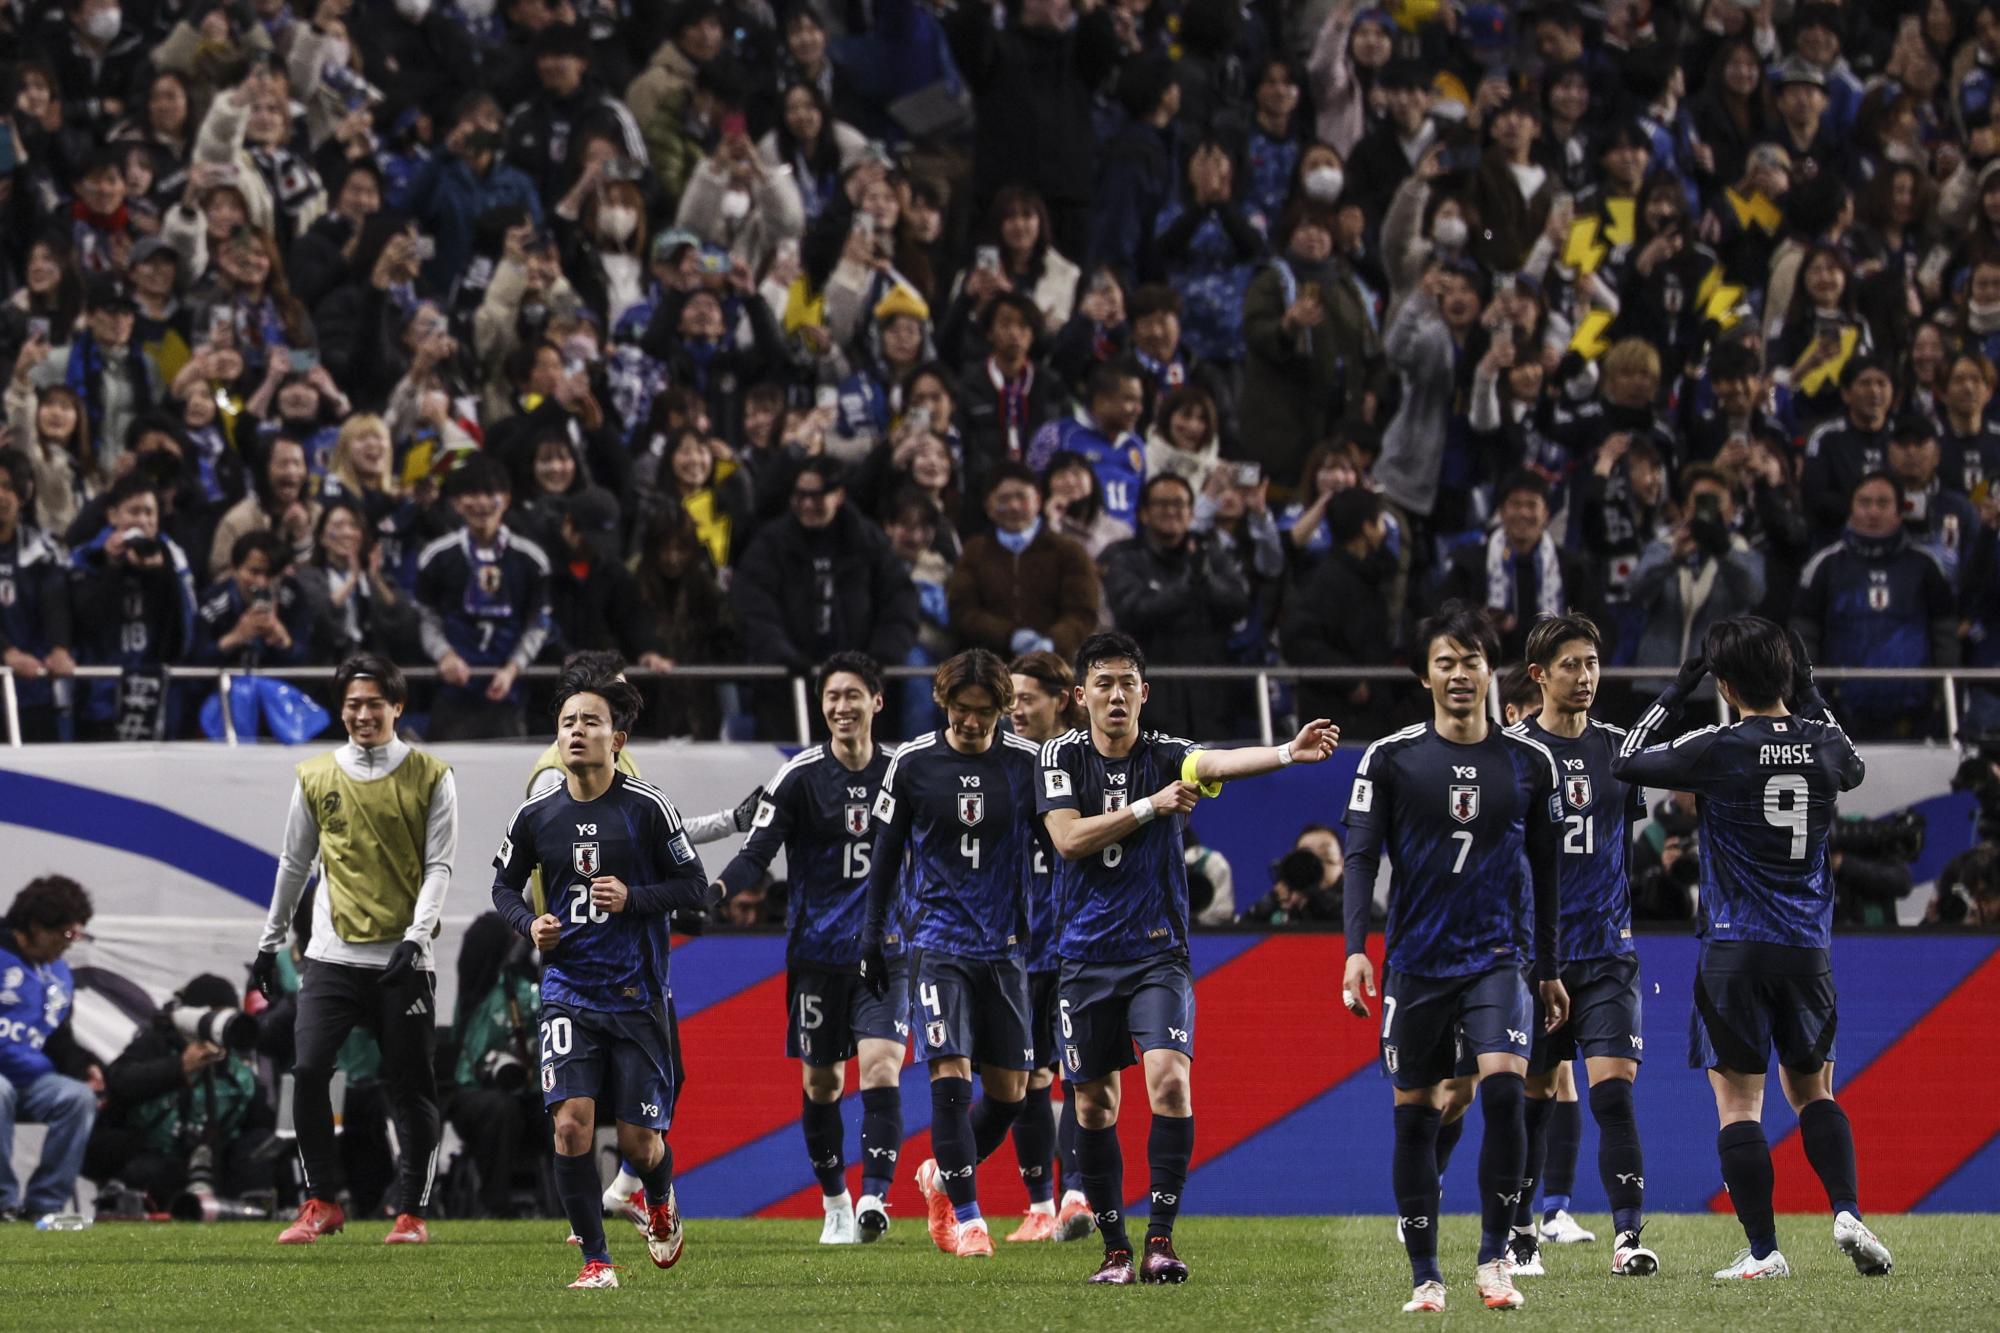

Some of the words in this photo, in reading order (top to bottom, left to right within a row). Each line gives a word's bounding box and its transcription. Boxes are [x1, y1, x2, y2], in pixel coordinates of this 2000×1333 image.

[478, 622, 494, 651] 7
[1760, 744, 1814, 764] AYASE
[1452, 766, 1477, 779] Y-3
[1563, 759, 1584, 771] Y-3
[959, 776, 981, 788] Y-3
[1106, 773, 1126, 785] Y-3
[847, 787, 867, 798] Y-3
[1764, 774, 1809, 860] 9
[576, 823, 598, 836] Y-3
[1564, 815, 1593, 853] 21
[960, 833, 980, 868] 4
[1452, 831, 1473, 873] 7
[843, 843, 871, 878] 15
[569, 884, 610, 924] 20
[920, 982, 941, 1016] 4
[800, 993, 823, 1029] 15
[1060, 999, 1073, 1039] 6
[1383, 996, 1397, 1038] 7
[540, 1017, 573, 1062] 20
[1168, 1027, 1188, 1043] Y-3
[1506, 1028, 1528, 1045] Y-3
[641, 1102, 658, 1117] Y-3
[868, 1147, 897, 1162] Y-3
[940, 1165, 972, 1180] Y-3
[1616, 1173, 1644, 1189] Y-3
[1151, 1191, 1177, 1205] Y-3
[1095, 1210, 1118, 1223] Y-3
[1400, 1216, 1429, 1229] Y-3
